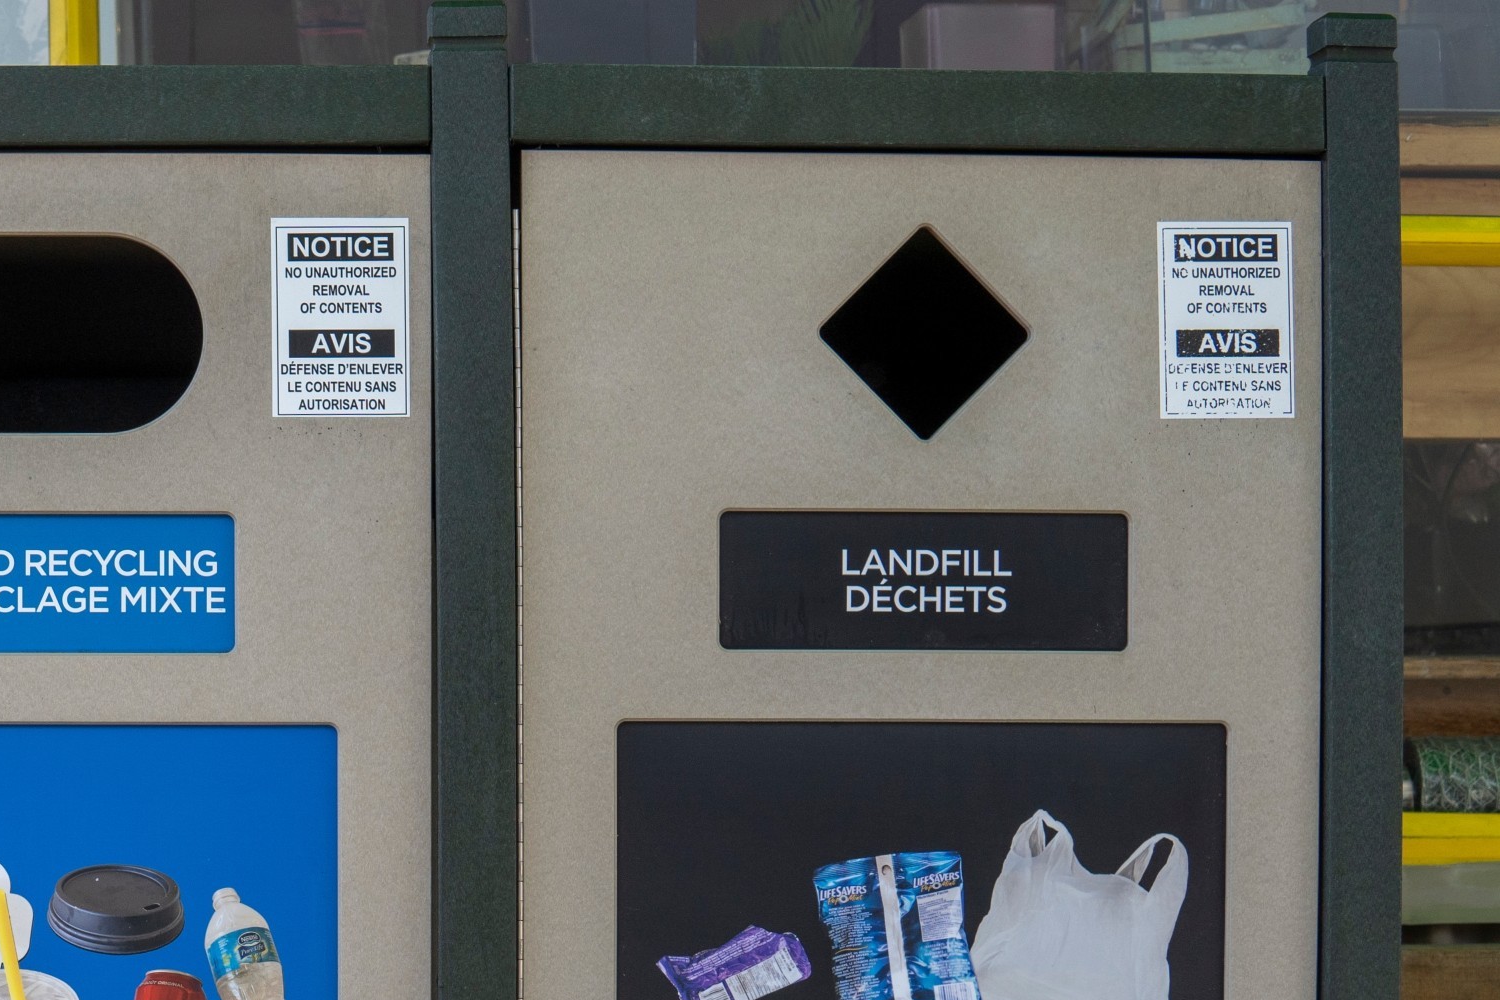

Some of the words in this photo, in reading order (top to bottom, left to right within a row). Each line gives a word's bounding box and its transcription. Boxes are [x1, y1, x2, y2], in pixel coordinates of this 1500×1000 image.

[293, 236, 389, 257] NOTICE
[1179, 237, 1273, 258] NOTICE
[285, 267, 302, 278] NO
[305, 267, 397, 278] UNAUTHORIZED
[1172, 268, 1189, 279] NO
[1192, 267, 1280, 278] UNAUTHORIZED
[312, 285, 370, 296] REMOVAL
[1199, 285, 1255, 296] REMOVAL
[300, 303, 316, 313] OF
[319, 302, 382, 313] CONTENTS
[1187, 303, 1203, 313] OF
[1205, 302, 1267, 313] CONTENTS
[311, 333, 371, 354] AVIS
[1198, 333, 1257, 353] AVIS
[281, 361, 334, 375] DÉFENSE
[338, 363, 403, 375] D'ENLEVER
[287, 382, 302, 392] LE
[305, 381, 362, 392] CONTENU
[365, 381, 397, 392] SANS
[1193, 381, 1247, 391] CONTENU
[1251, 380, 1282, 391] SANS
[298, 399, 386, 410] AUTORISATION
[25, 549, 218, 577] RECYCLING
[841, 548, 1012, 577] LANDFILL
[120, 586, 226, 613] MIXTE
[845, 579, 1007, 613] DÉCHETS
